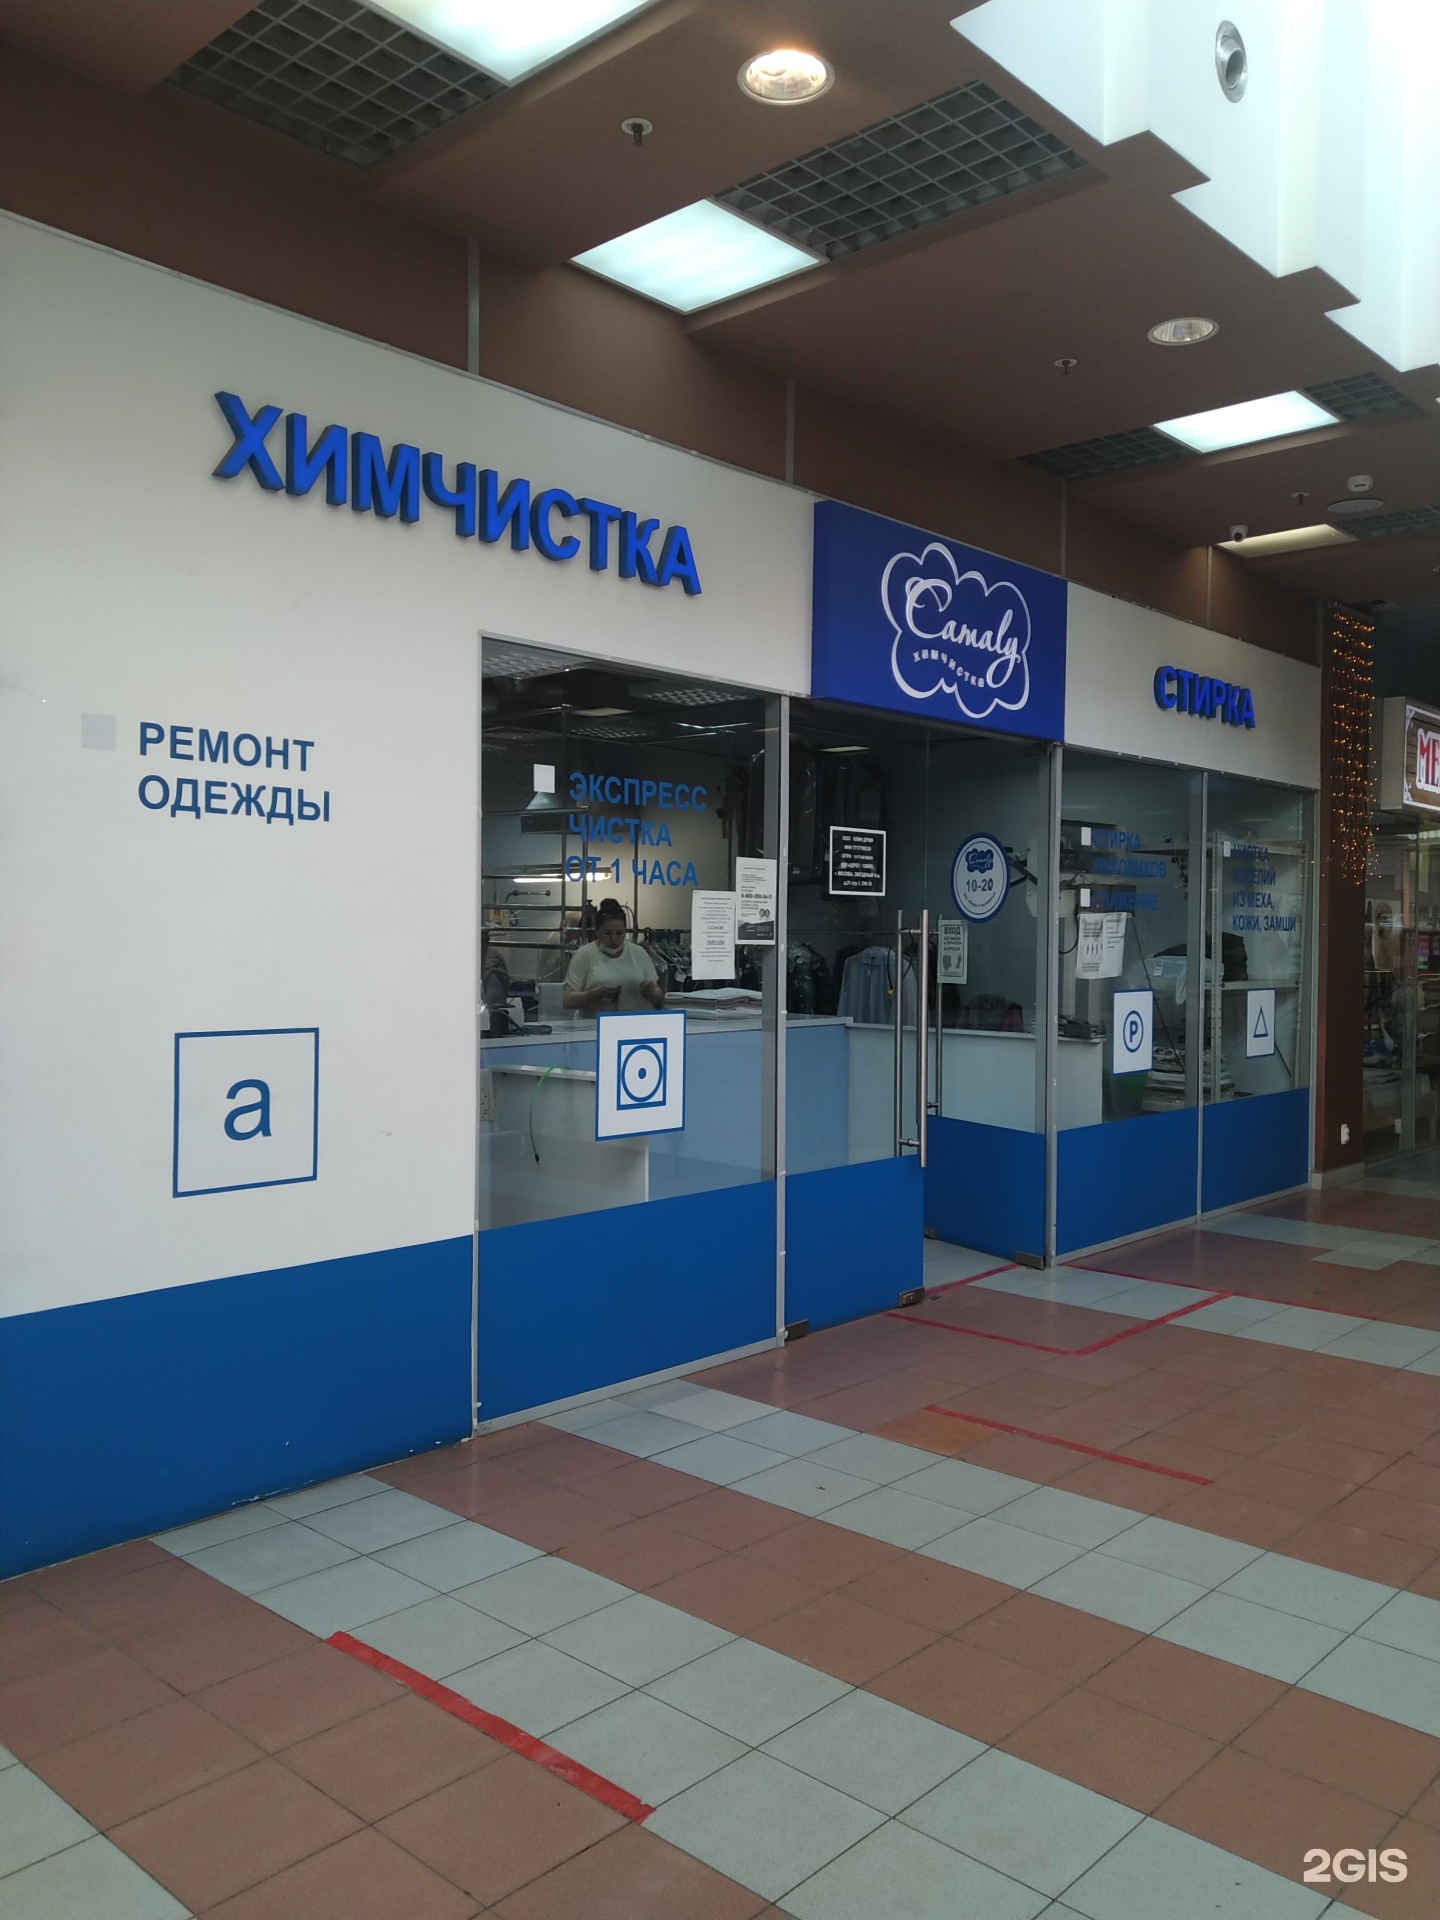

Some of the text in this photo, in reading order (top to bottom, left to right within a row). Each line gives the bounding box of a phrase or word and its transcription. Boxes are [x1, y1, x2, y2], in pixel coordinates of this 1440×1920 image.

[212, 390, 702, 596] ХИМЧИСТКА
[905, 576, 1021, 688] Camaly
[1153, 665, 1256, 728] СТИРКА
[139, 721, 315, 772] РЕМОНТ
[138, 774, 330, 826] ОДЕЖДЫ
[569, 772, 707, 812] ЭКСПРЕСС
[568, 813, 672, 847] ЧИСТКА
[1093, 829, 1141, 849] СТИРКА
[565, 855, 699, 887] ОТ 1 ЧАСА
[966, 878, 993, 892] 10-20
[1232, 891, 1275, 910] ИЗ МЕХА,
[944, 926, 962, 936] ВХОД
[1232, 914, 1297, 933] КОЖИ, ЗАМШИ
